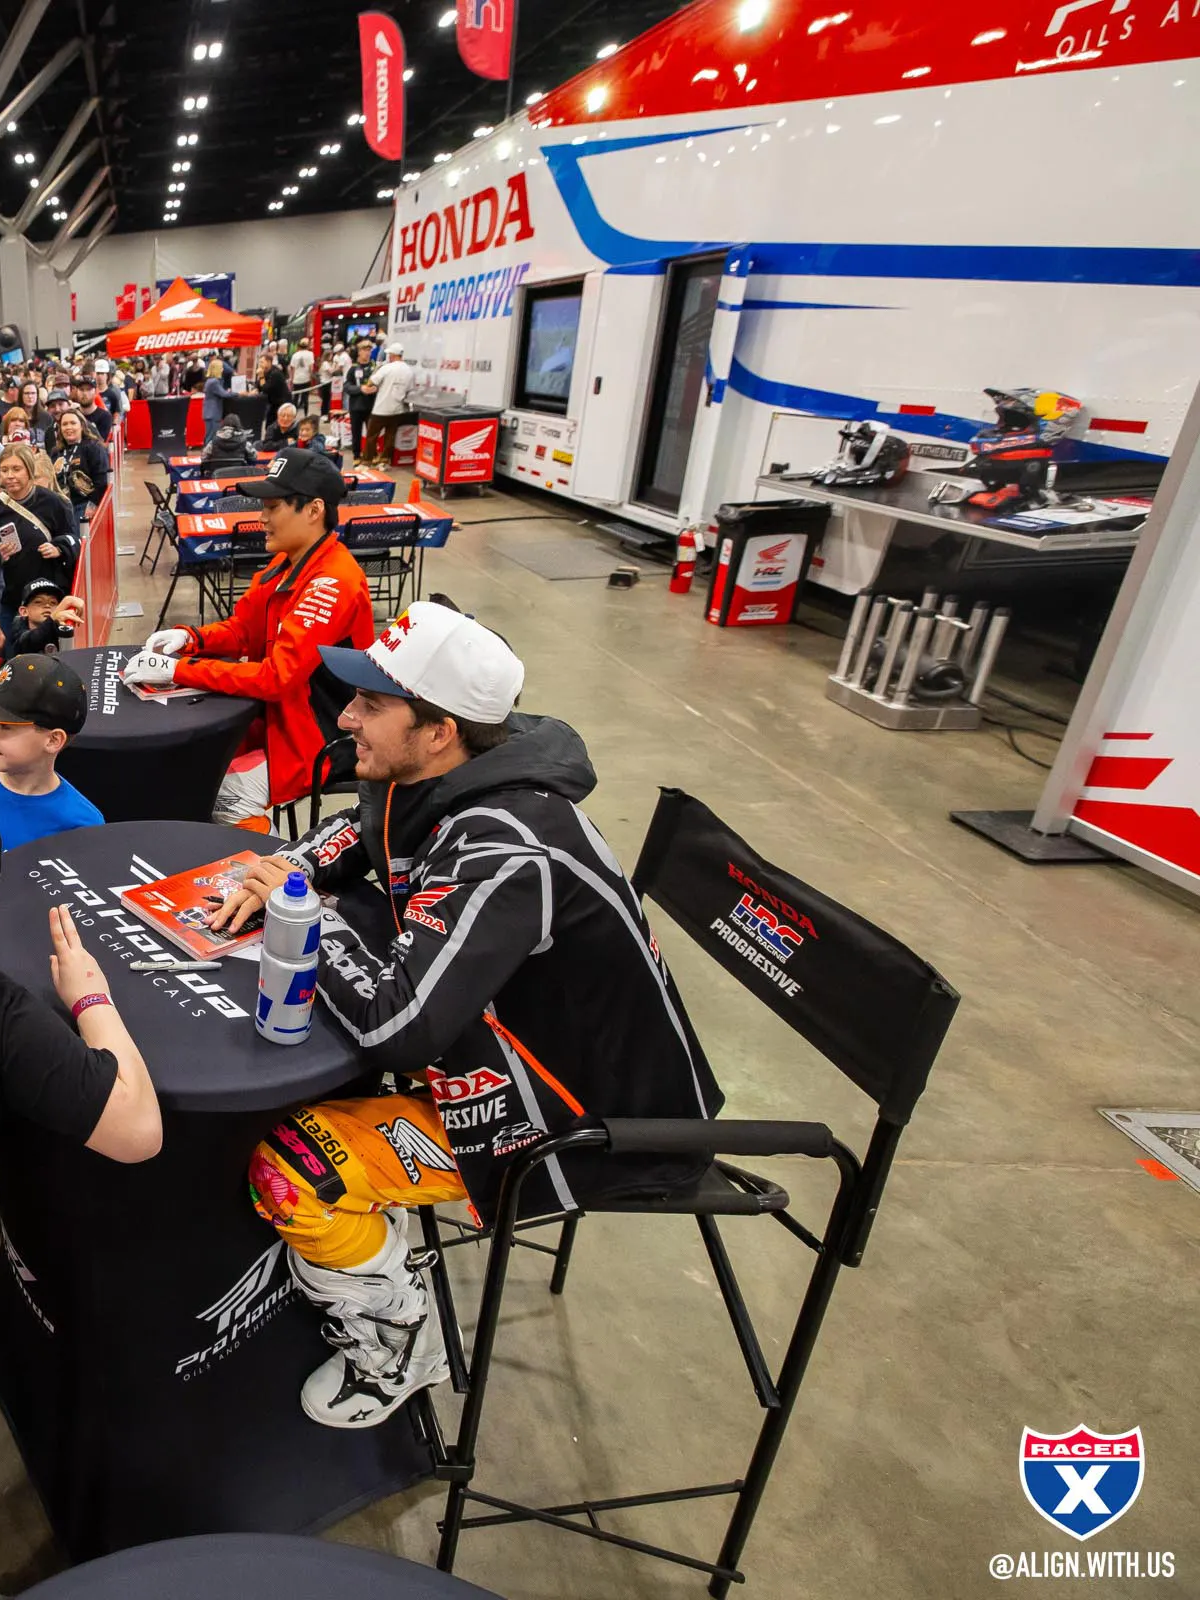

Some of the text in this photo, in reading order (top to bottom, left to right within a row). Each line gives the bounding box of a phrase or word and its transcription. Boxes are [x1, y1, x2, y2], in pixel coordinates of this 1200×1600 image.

[1056, 15, 1136, 58] OILS
[376, 57, 389, 143] HONDA
[398, 171, 535, 276] HONDA
[134, 328, 233, 352] PROGRESSIVE
[910, 442, 968, 462] FEATHERLITE
[138, 657, 169, 669] FOX
[403, 908, 448, 935] ONDA
[727, 862, 820, 940] HONDA
[29, 870, 61, 896] OILS
[63, 902, 95, 926] AND
[99, 934, 206, 1018] CHEICALS
[733, 893, 804, 959] HRC
[710, 917, 802, 998] PROGRESSIVE
[755, 935, 786, 964] RACING
[295, 1109, 349, 1166] sta360
[493, 1133, 542, 1156] RENTHA
[183, 1362, 211, 1381] OILS
[219, 1341, 240, 1360] AND
